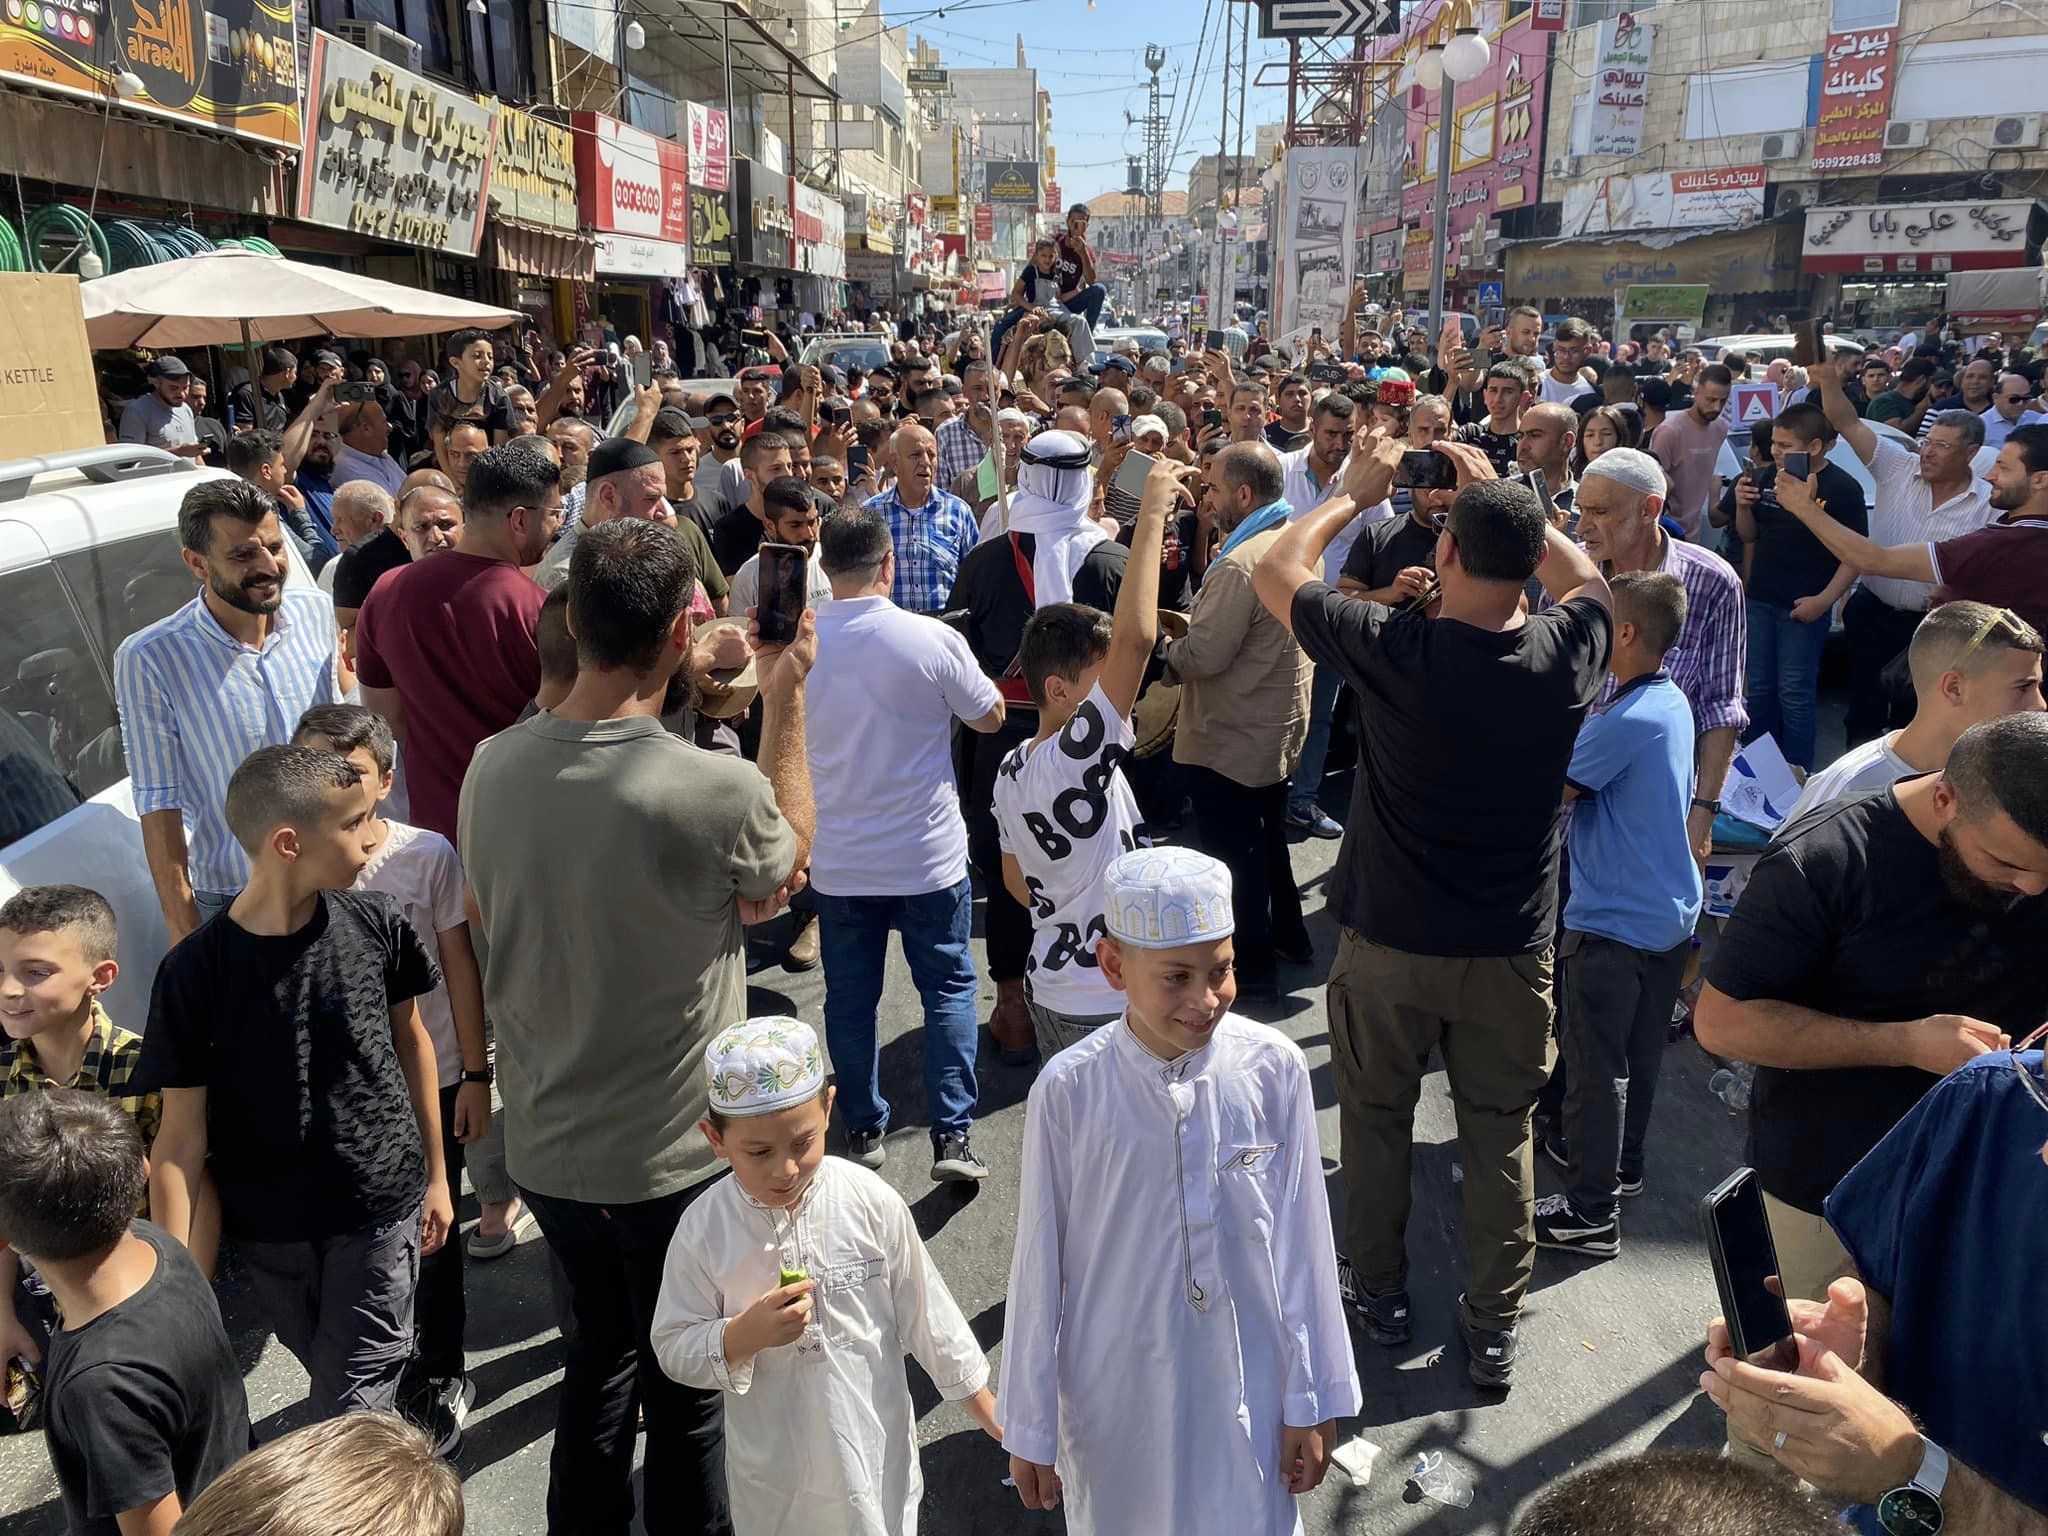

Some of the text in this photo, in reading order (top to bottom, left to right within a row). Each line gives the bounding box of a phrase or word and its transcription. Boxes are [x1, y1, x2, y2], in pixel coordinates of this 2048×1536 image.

[1828, 32, 1890, 67] بيوتي
[1603, 68, 1645, 88] بيوتي
[1824, 65, 1887, 97] كلينك
[1599, 93, 1644, 110] كلينك
[1820, 101, 1884, 125] المركز الطبي
[1812, 153, 1882, 170] 0599228438
[1680, 171, 1760, 190] بيوتي كلينك
[614, 179, 661, 216] ooredoo
[1868, 210, 1899, 240] بابا
[1905, 208, 1956, 247] علي
[4, 368, 55, 384] KETTLE
[1486, 1347, 1503, 1356] NIKE
